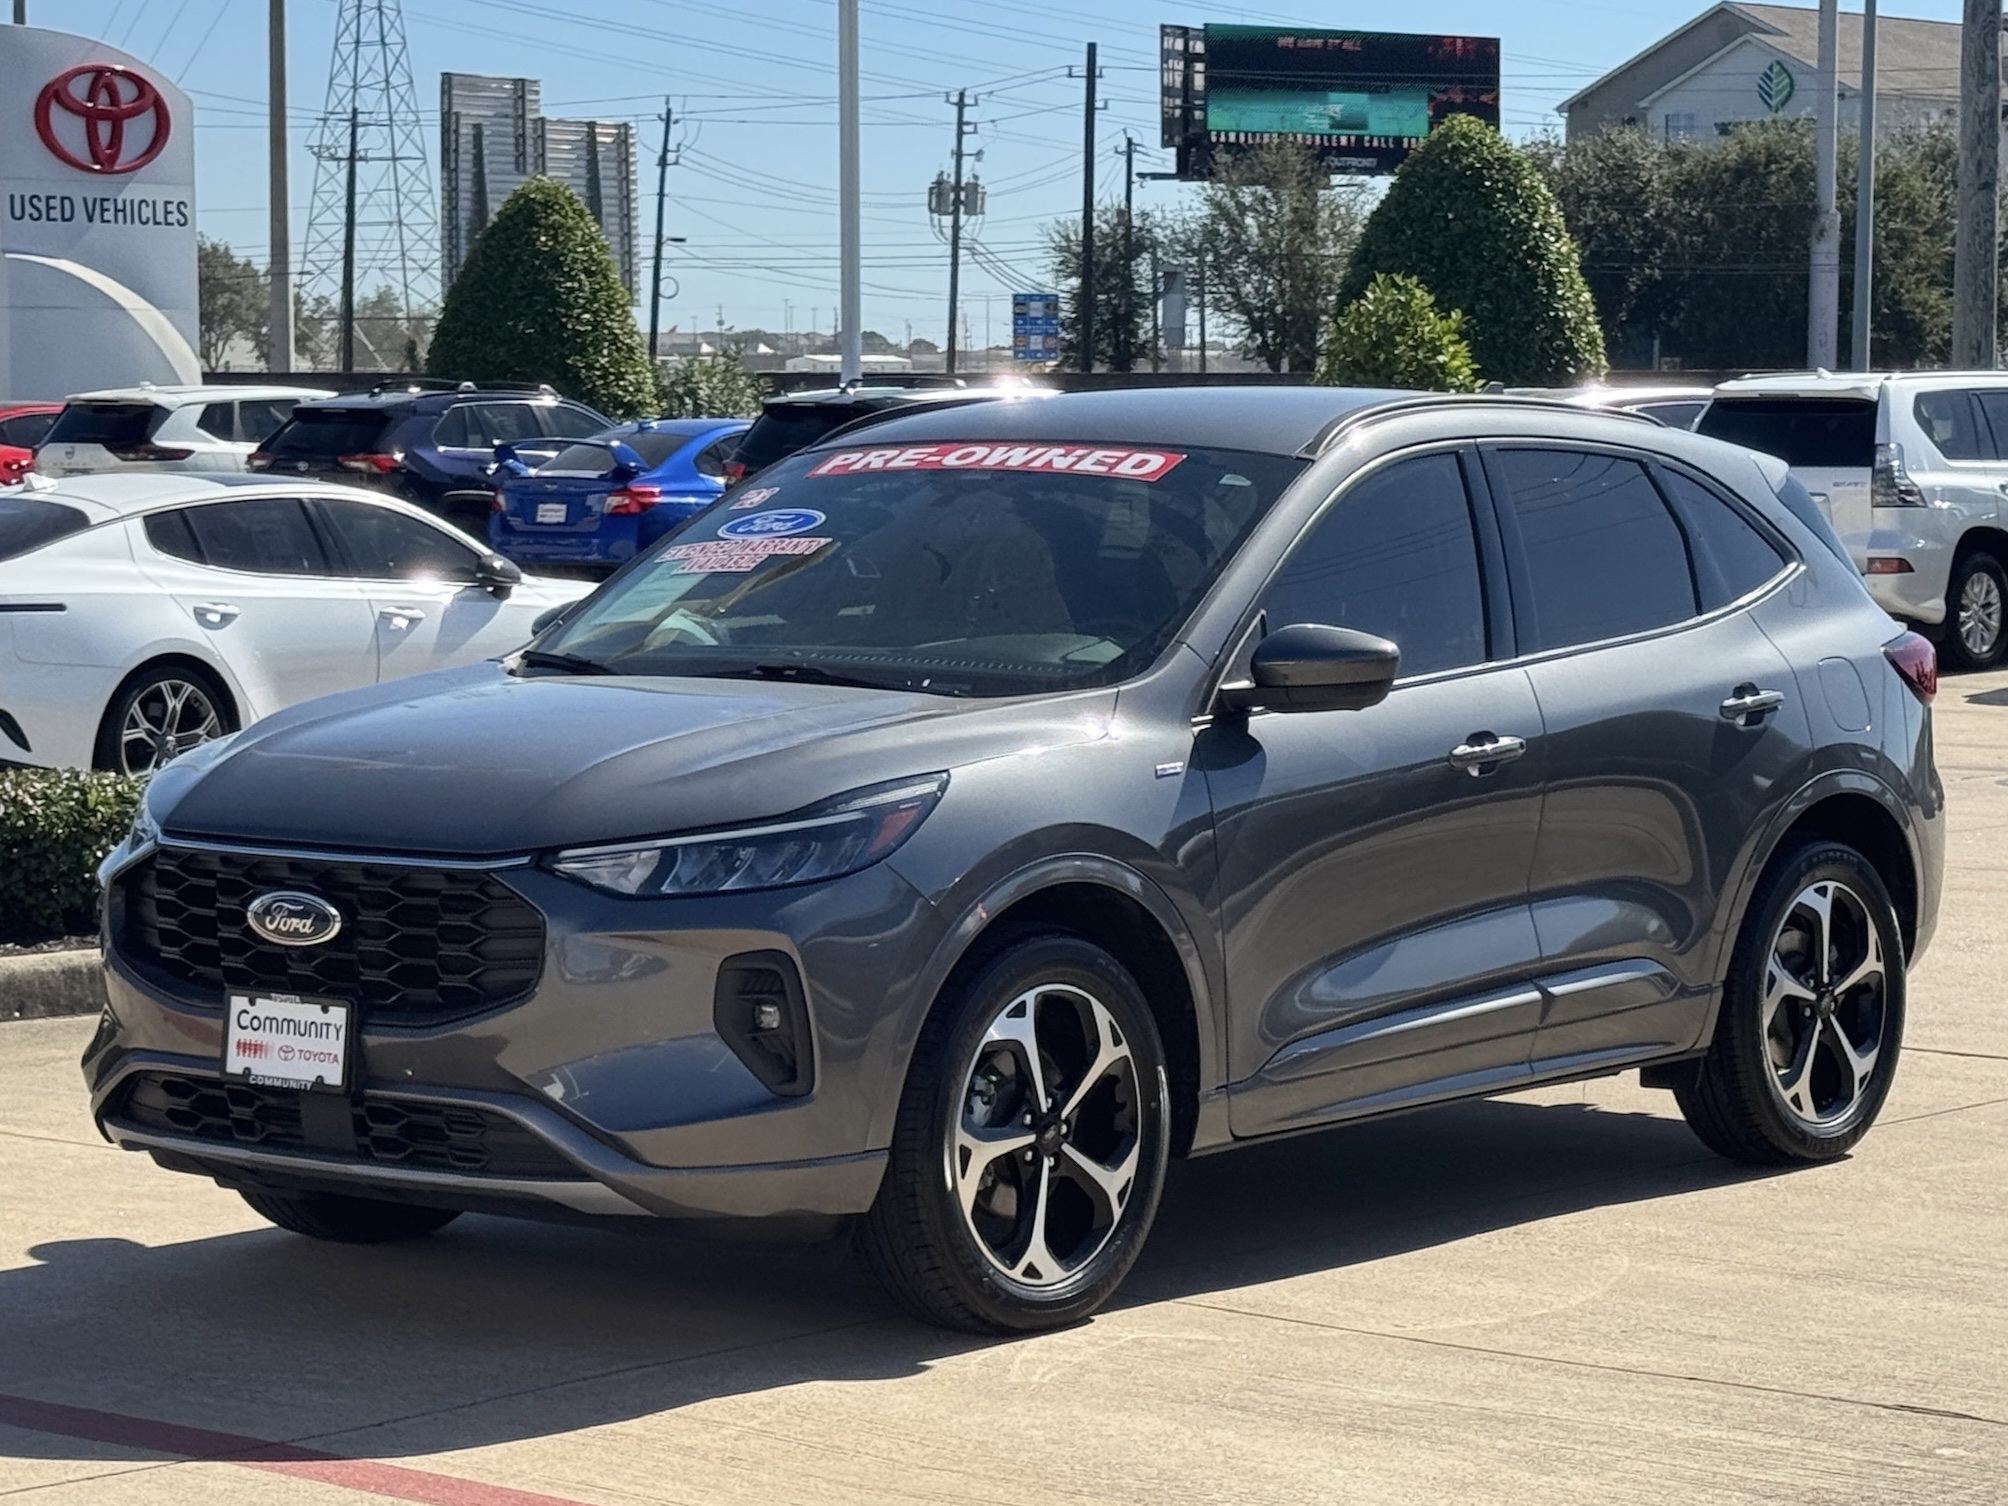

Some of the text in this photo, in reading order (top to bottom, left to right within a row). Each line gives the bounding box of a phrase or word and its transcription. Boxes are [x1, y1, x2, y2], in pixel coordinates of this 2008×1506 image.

[9, 193, 189, 227] USED VEHICLES
[815, 445, 1167, 476] PRE-OWNED
[737, 514, 804, 533] Ford
[264, 902, 315, 934] Ford
[297, 1049, 340, 1065] TOYOTA
[249, 1074, 313, 1091] COMMUNITY
